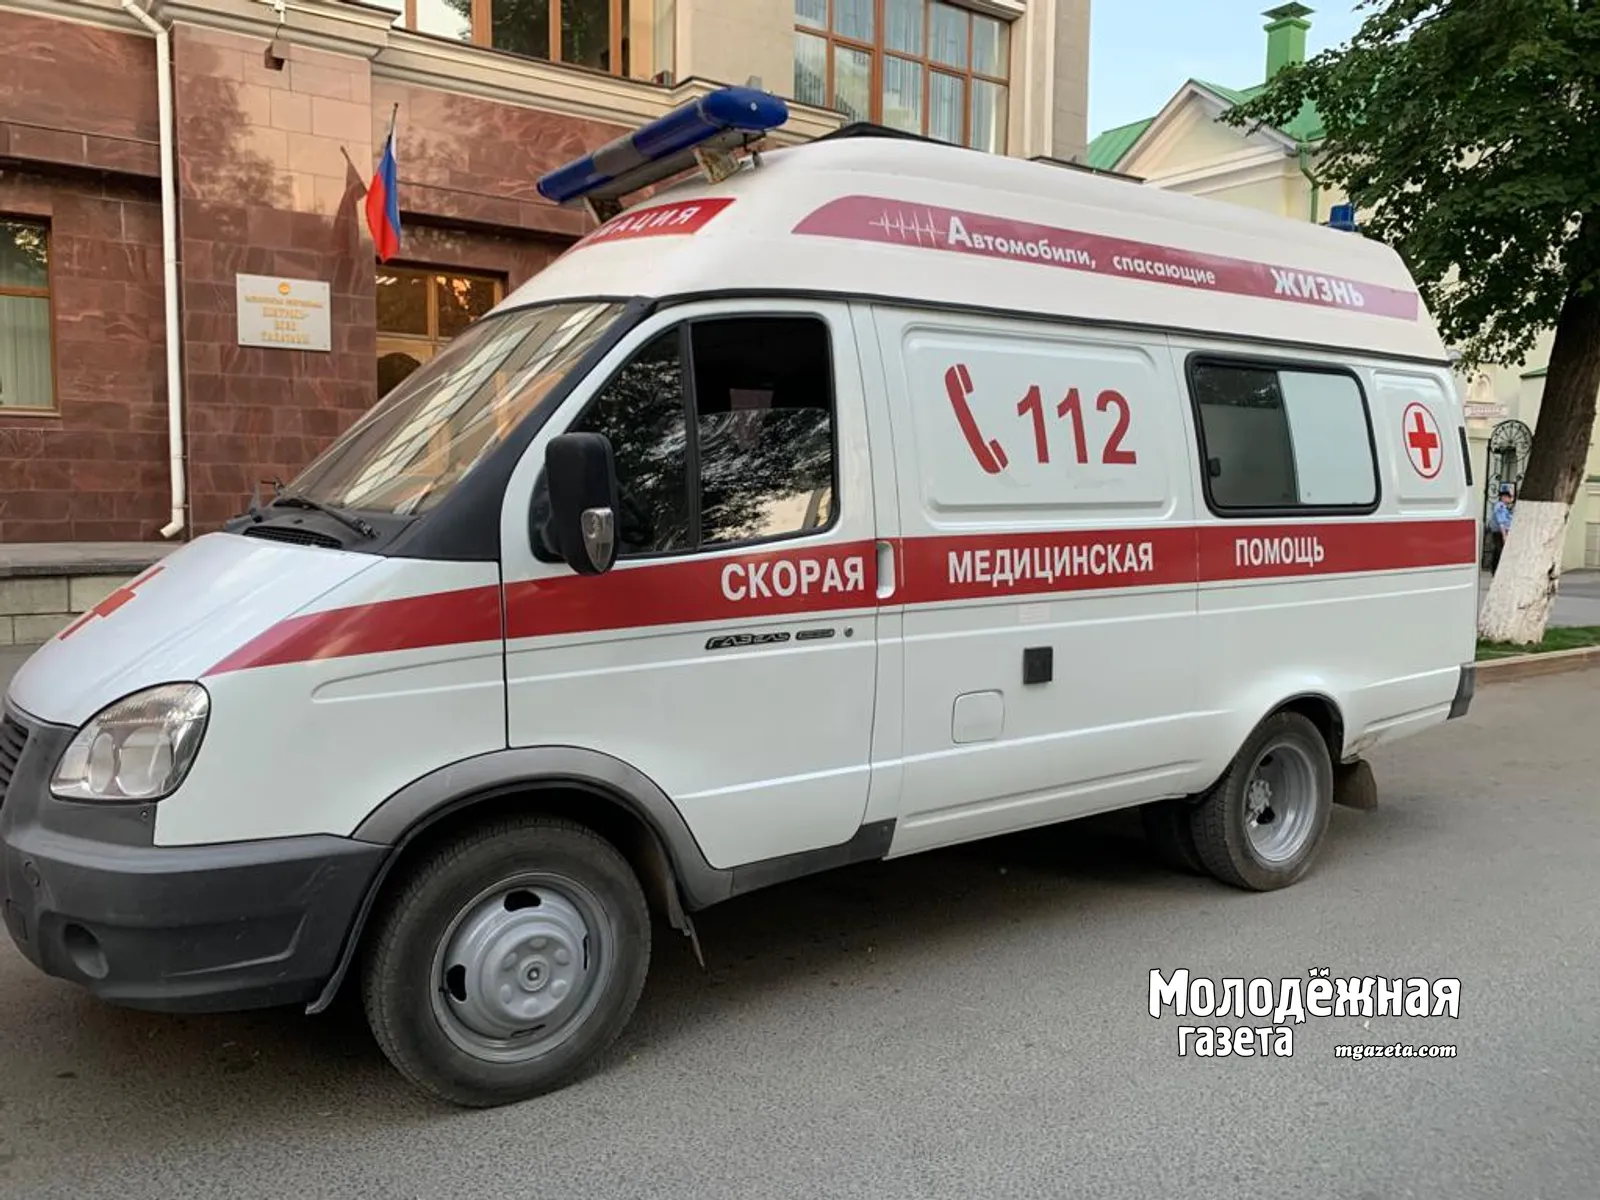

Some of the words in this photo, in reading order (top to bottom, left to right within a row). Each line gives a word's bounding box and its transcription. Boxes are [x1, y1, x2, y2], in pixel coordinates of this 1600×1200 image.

[947, 215, 1097, 269] Автомобили,
[1112, 254, 1217, 287] спасающие
[1271, 267, 1365, 308] ЖИЗНЬ
[1017, 385, 1137, 465] 112
[721, 556, 865, 601] СКОРАЯ
[948, 542, 1154, 587] МЕДИЦИНСКАЯ
[1235, 537, 1325, 568] ПОМОЩЬ
